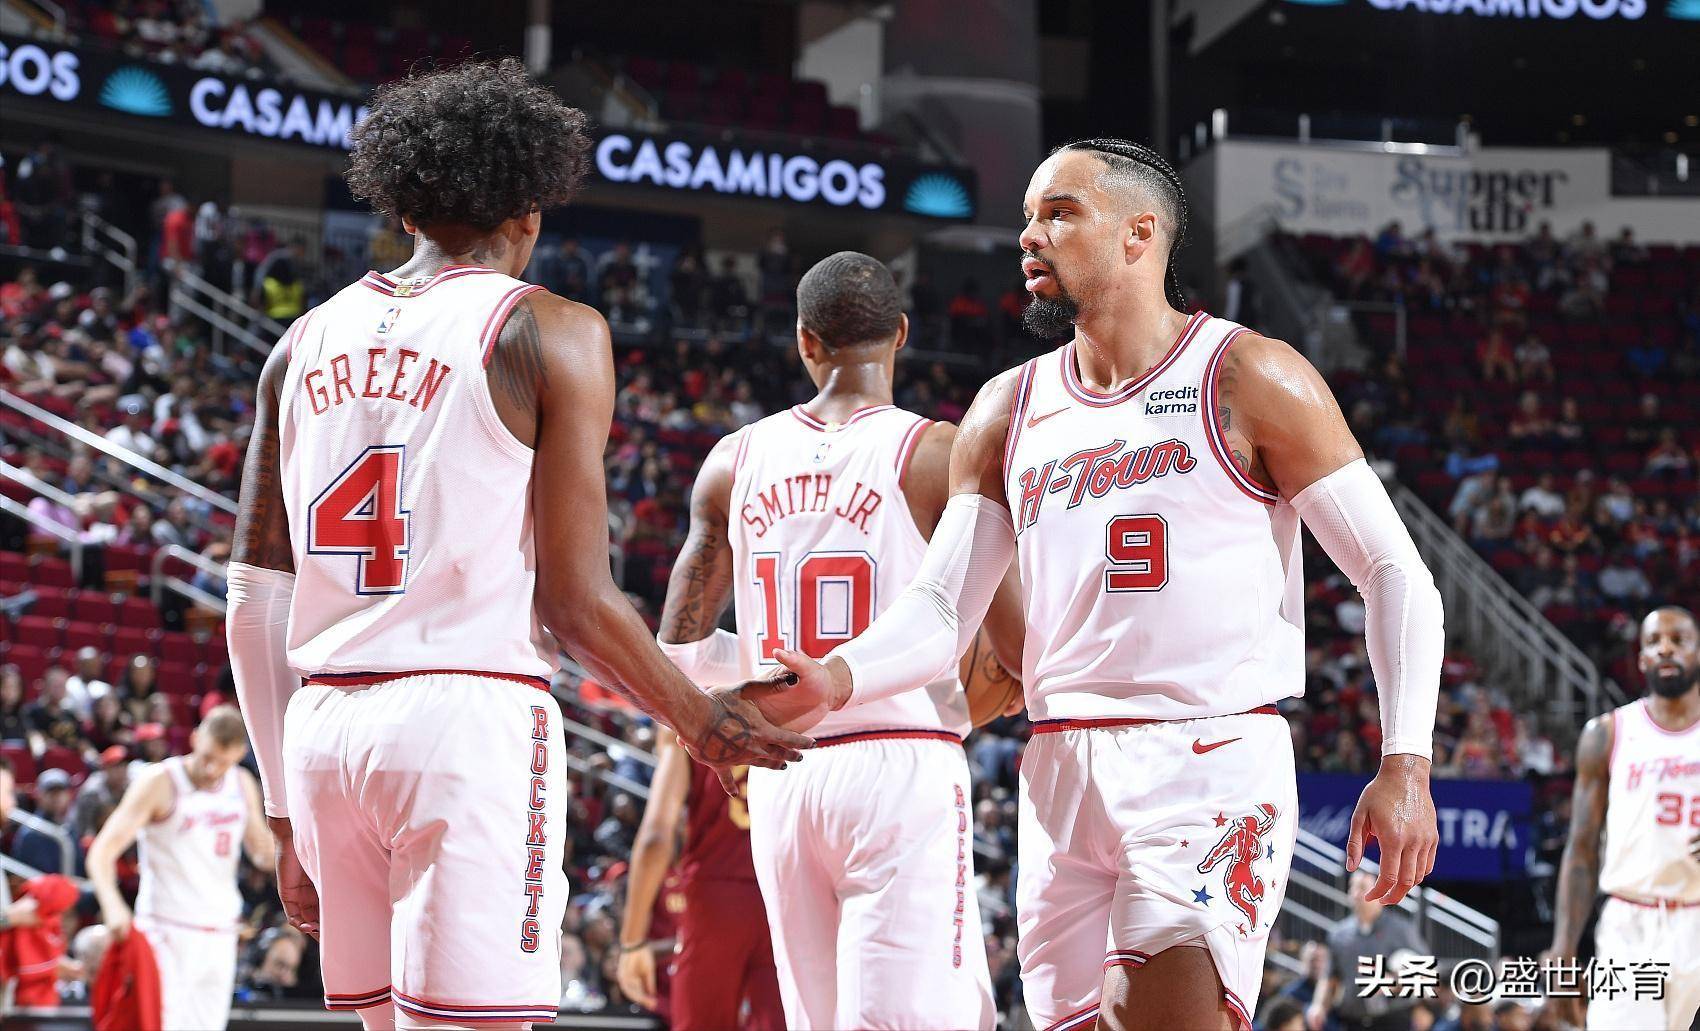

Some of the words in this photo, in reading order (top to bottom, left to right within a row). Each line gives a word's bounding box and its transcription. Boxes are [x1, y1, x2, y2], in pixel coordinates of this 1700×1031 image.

[0, 42, 80, 101] OS
[189, 77, 369, 150] CASAM
[596, 134, 886, 209] CASAMIGOS
[305, 348, 450, 415] GREEN
[1145, 402, 1197, 415] karma
[1149, 386, 1198, 401] credit
[307, 444, 411, 595] 4
[741, 474, 832, 538] SMITH
[835, 482, 883, 536] JR.
[1017, 438, 1198, 537] H-Town
[1105, 513, 1169, 593] 9
[752, 550, 877, 665] 10
[520, 705, 549, 954] ROCKETS
[1437, 807, 1518, 850] TRA
[952, 782, 967, 969] ROCKETS
